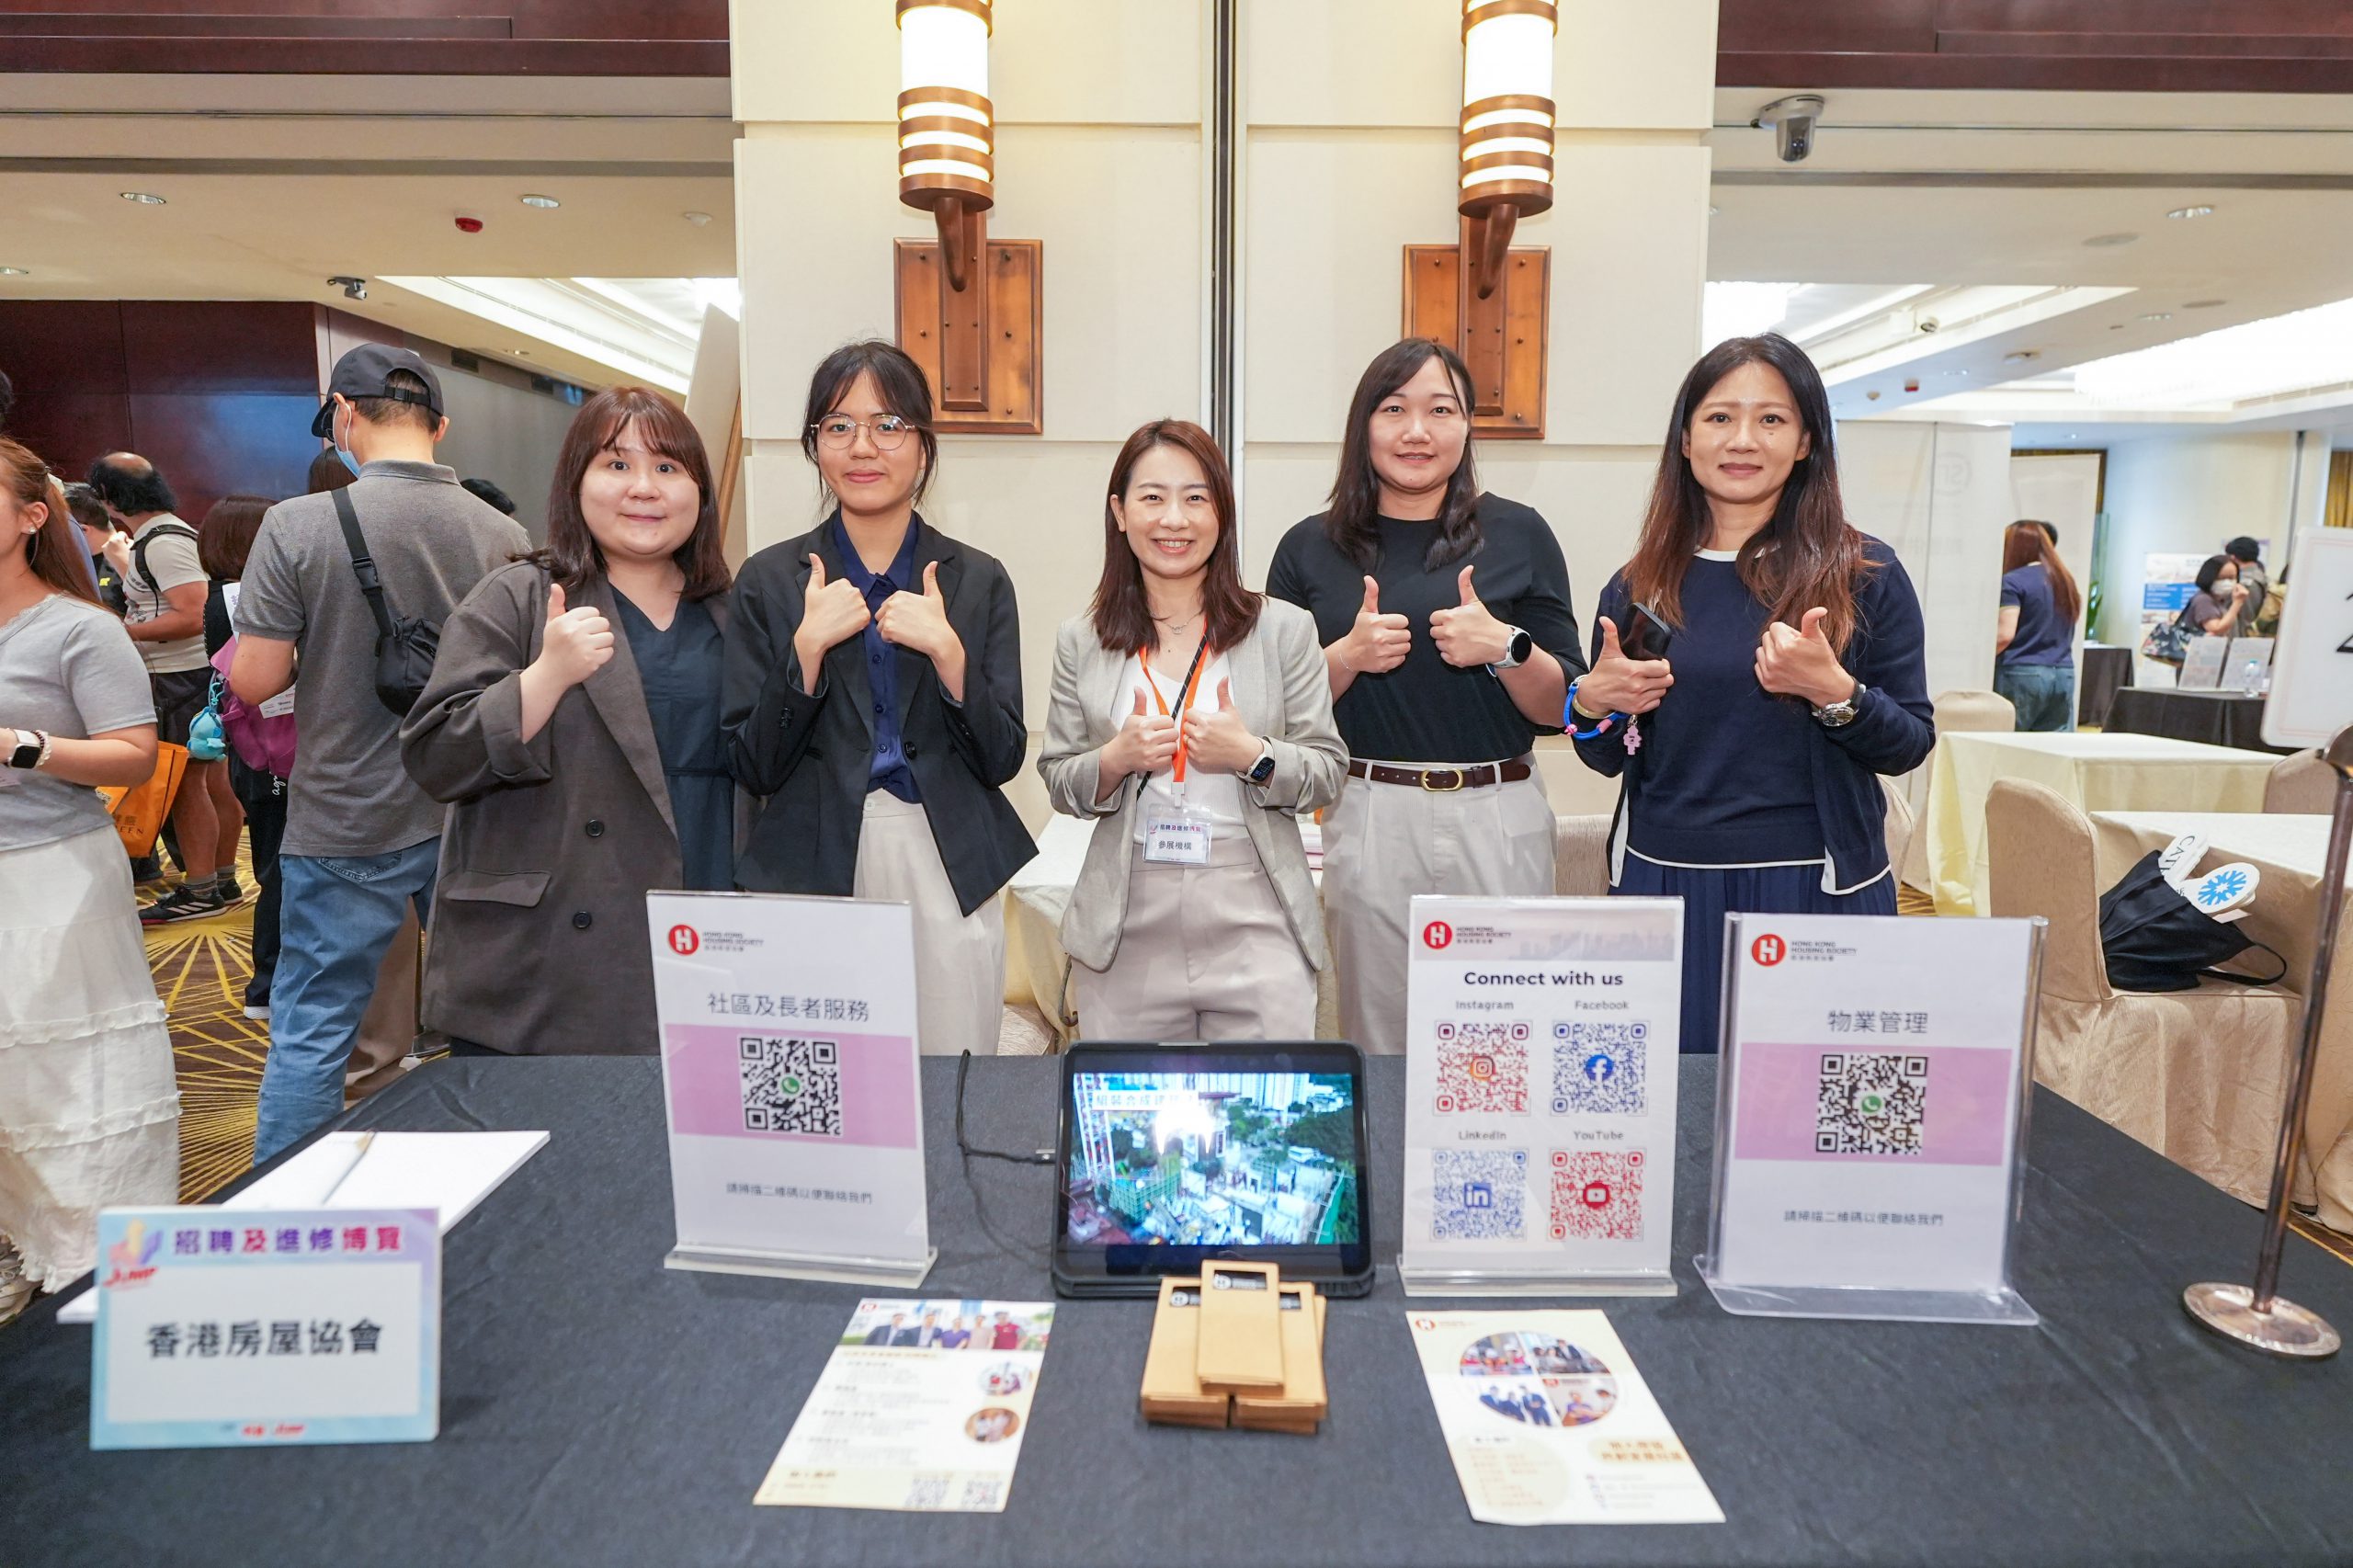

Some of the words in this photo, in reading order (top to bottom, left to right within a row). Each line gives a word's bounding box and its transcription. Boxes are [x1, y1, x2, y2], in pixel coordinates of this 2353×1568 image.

[1464, 971, 1546, 985] Connect
[1552, 971, 1595, 985] with
[1602, 974, 1624, 985] us
[707, 992, 870, 1023] 社區及長者服務
[1455, 1000, 1514, 1012] Instagram
[1574, 1000, 1630, 1010] Facebook
[1827, 1009, 1929, 1034] 物業管理
[1458, 1131, 1507, 1142] LinkedIn
[1574, 1131, 1624, 1141] YouTube
[174, 1226, 401, 1256] 招聘及進修博覽
[145, 1318, 383, 1359] 香港房屋協會
